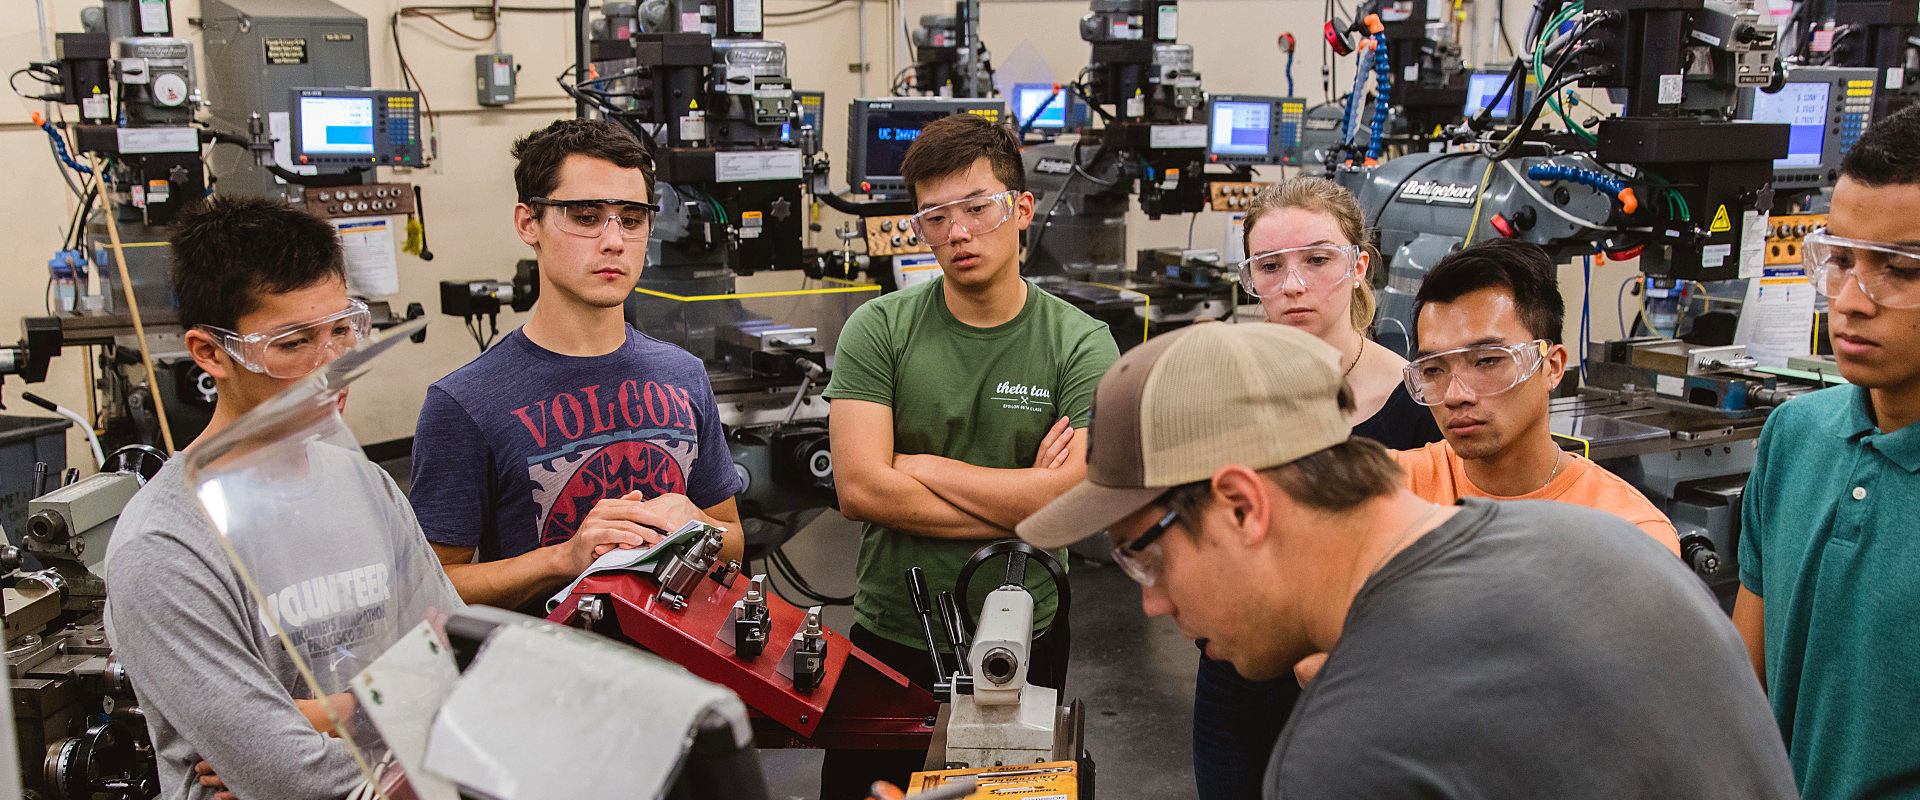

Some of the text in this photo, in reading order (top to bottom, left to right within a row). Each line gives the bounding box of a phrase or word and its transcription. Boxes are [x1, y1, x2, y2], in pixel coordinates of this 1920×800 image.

[878, 127, 892, 140] UC
[1402, 180, 1478, 204] Bridgeport
[996, 381, 1050, 398] theta tau
[510, 379, 697, 449] VOLCOM
[258, 562, 391, 637] VOLUNTEER
